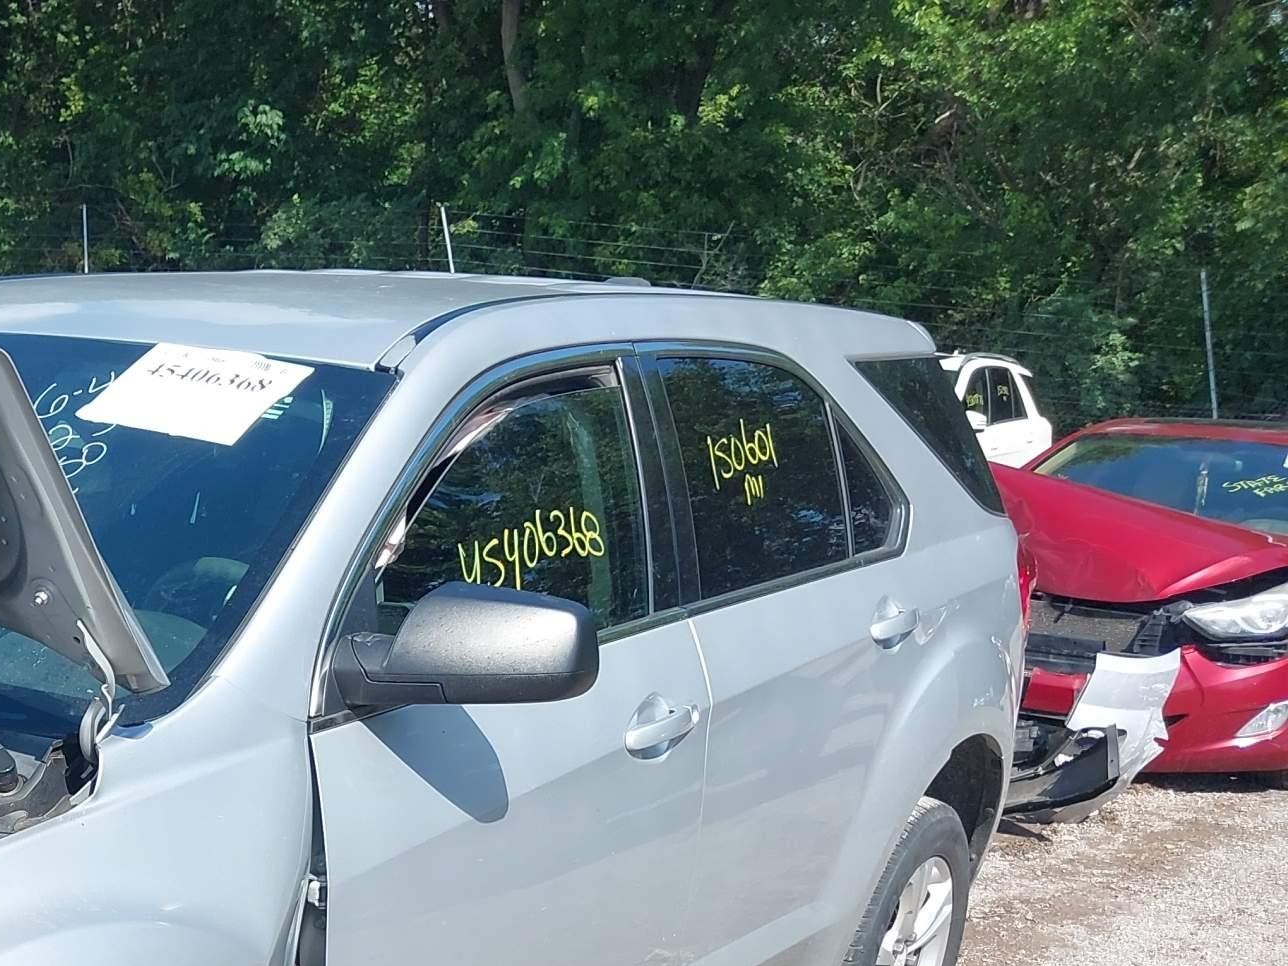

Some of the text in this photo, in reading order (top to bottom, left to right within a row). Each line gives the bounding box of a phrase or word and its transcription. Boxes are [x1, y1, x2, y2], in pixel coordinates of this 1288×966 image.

[146, 362, 273, 392] 45406368
[706, 418, 778, 490] 150601
[457, 507, 605, 590] 45406368
